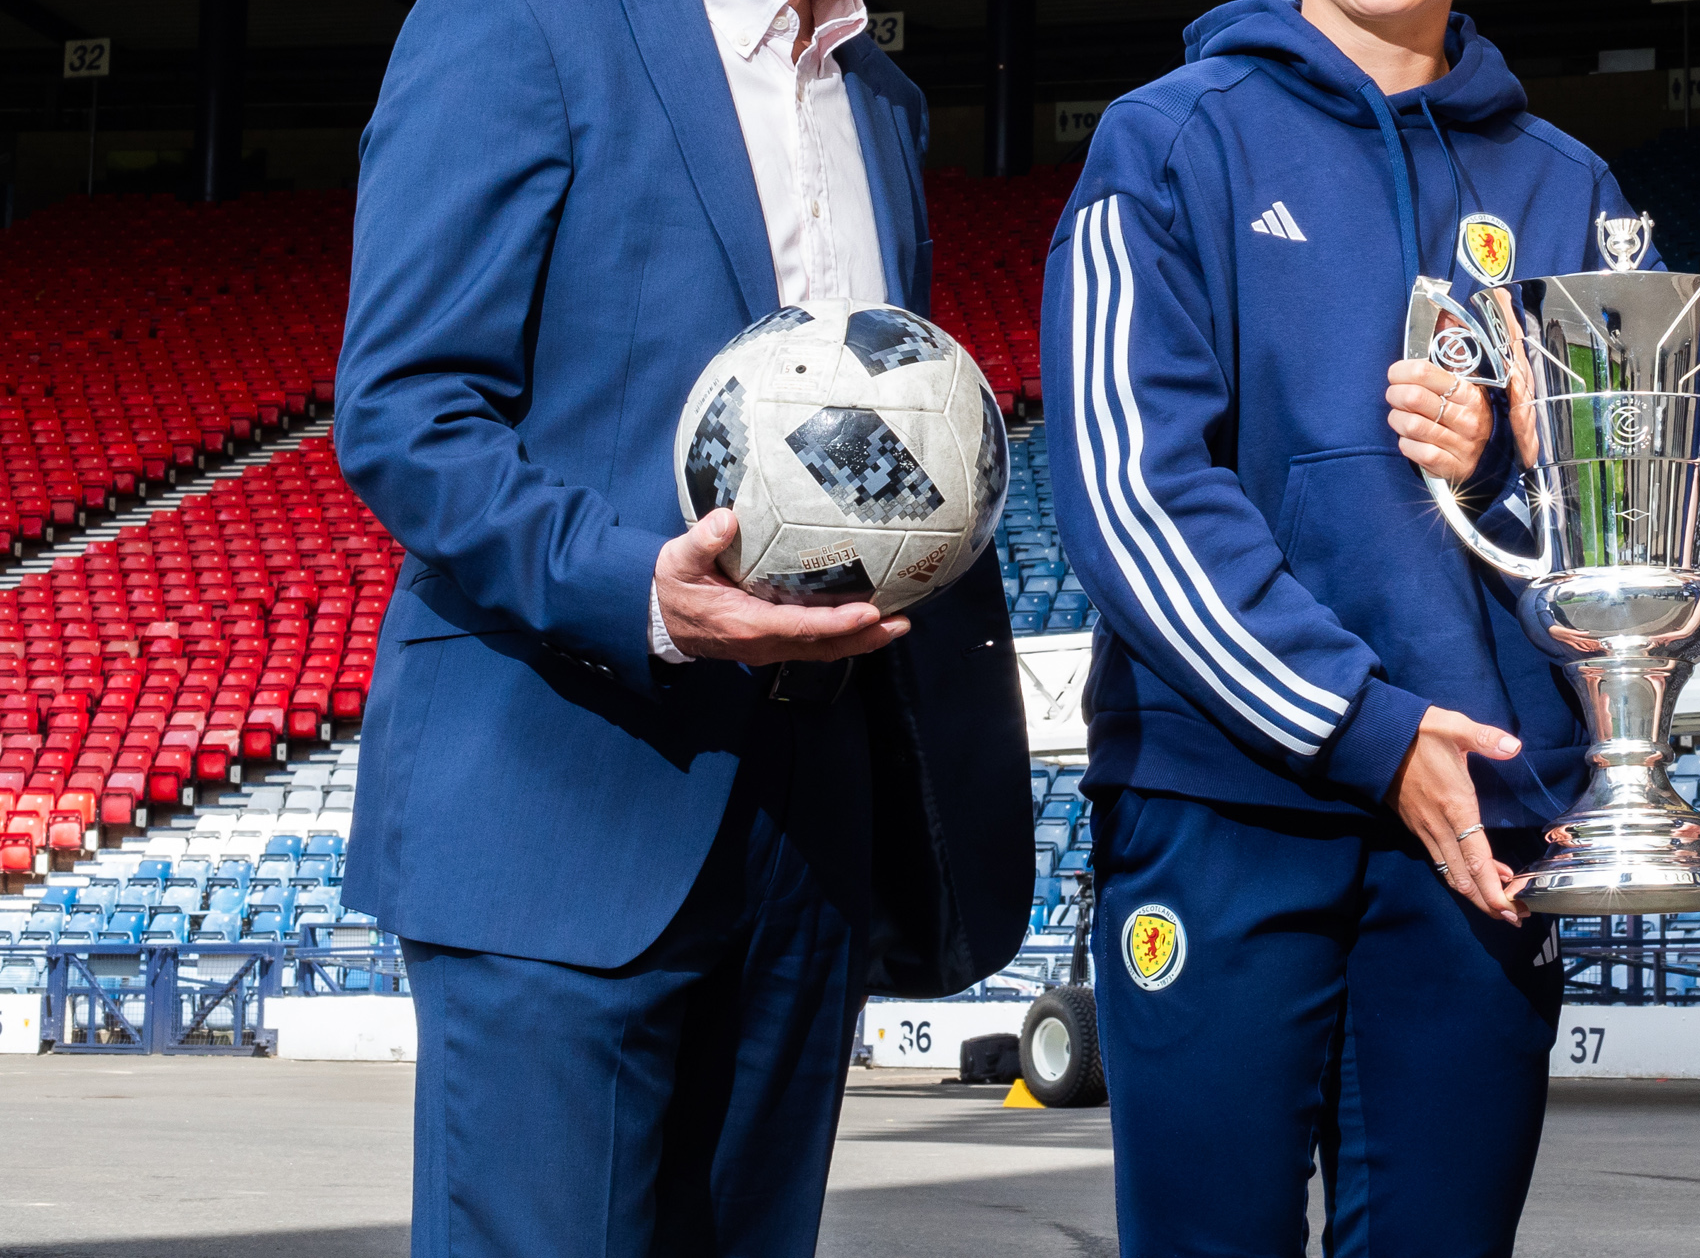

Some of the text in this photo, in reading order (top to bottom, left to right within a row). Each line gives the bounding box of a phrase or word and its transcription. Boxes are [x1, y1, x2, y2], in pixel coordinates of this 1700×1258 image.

[68, 44, 106, 72] 32
[1469, 214, 1507, 229] SCOTLAND
[801, 546, 859, 571] TELSTAR
[896, 542, 949, 580] adidas
[1141, 905, 1176, 922] SCOTLAND
[1159, 974, 1174, 988] 1873
[899, 1020, 932, 1054] 36
[1570, 1026, 1606, 1064] 37
